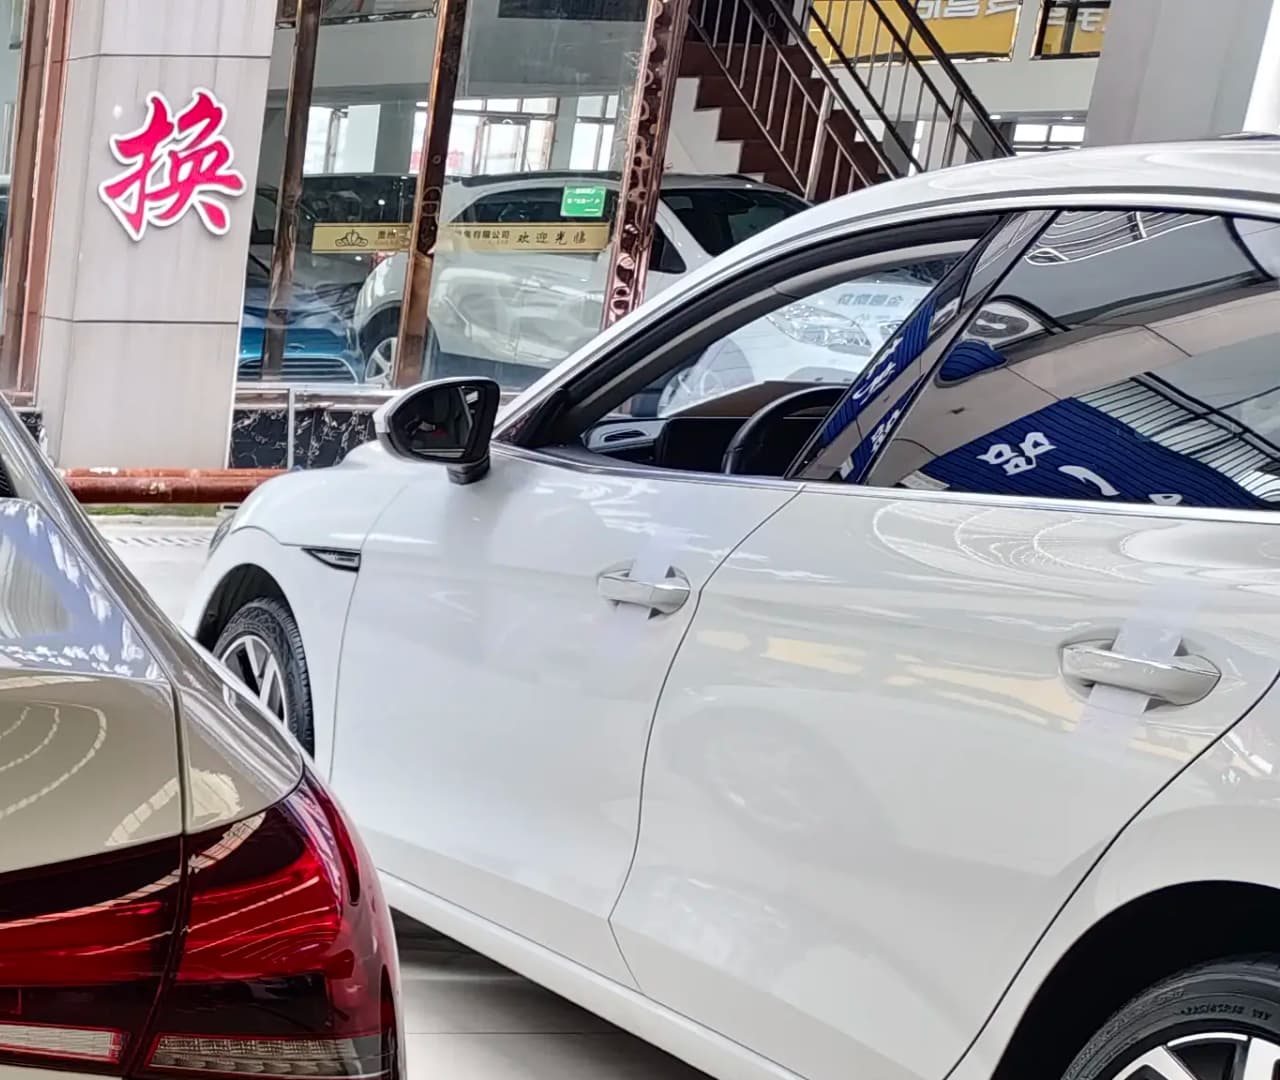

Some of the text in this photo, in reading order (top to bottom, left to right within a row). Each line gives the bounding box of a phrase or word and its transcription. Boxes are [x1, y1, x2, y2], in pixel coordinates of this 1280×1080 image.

[100, 87, 247, 241] 换
[515, 230, 587, 246] 欢迎光临
